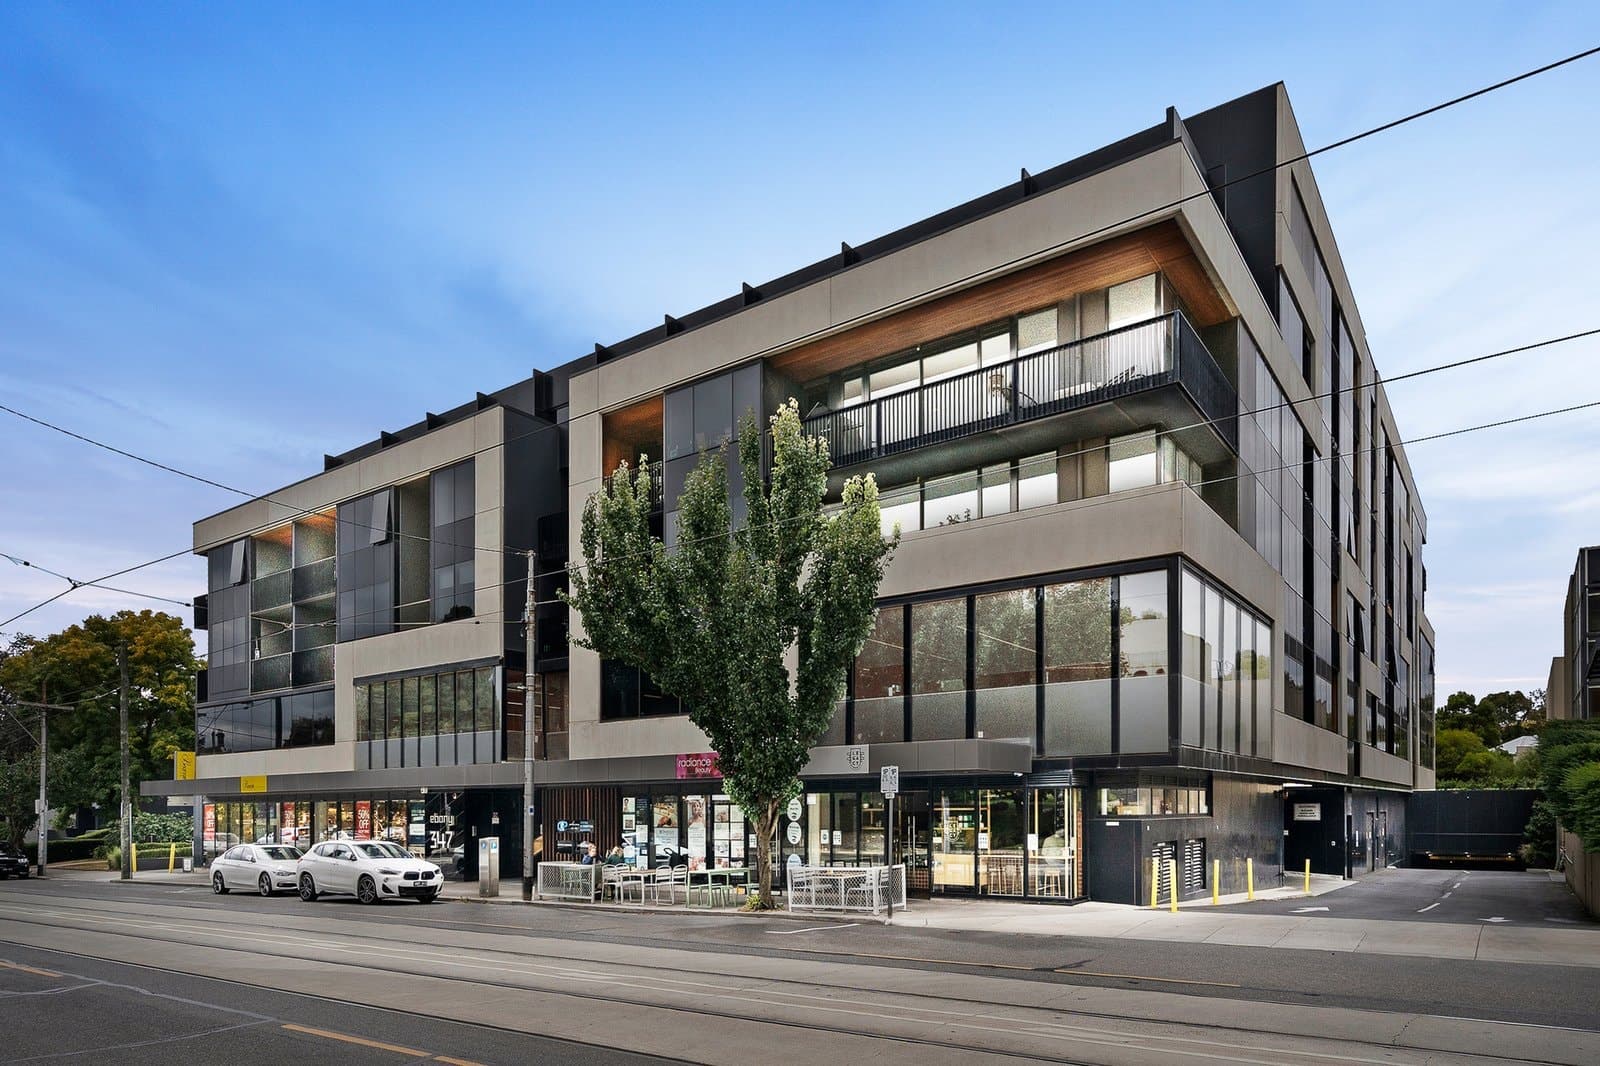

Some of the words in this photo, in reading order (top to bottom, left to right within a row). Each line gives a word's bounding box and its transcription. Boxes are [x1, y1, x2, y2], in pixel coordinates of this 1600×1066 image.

[678, 757, 711, 768] radiance
[357, 809, 370, 819] 50%
[429, 812, 455, 826] ebony
[358, 819, 369, 829] OFF
[429, 830, 453, 848] 347
